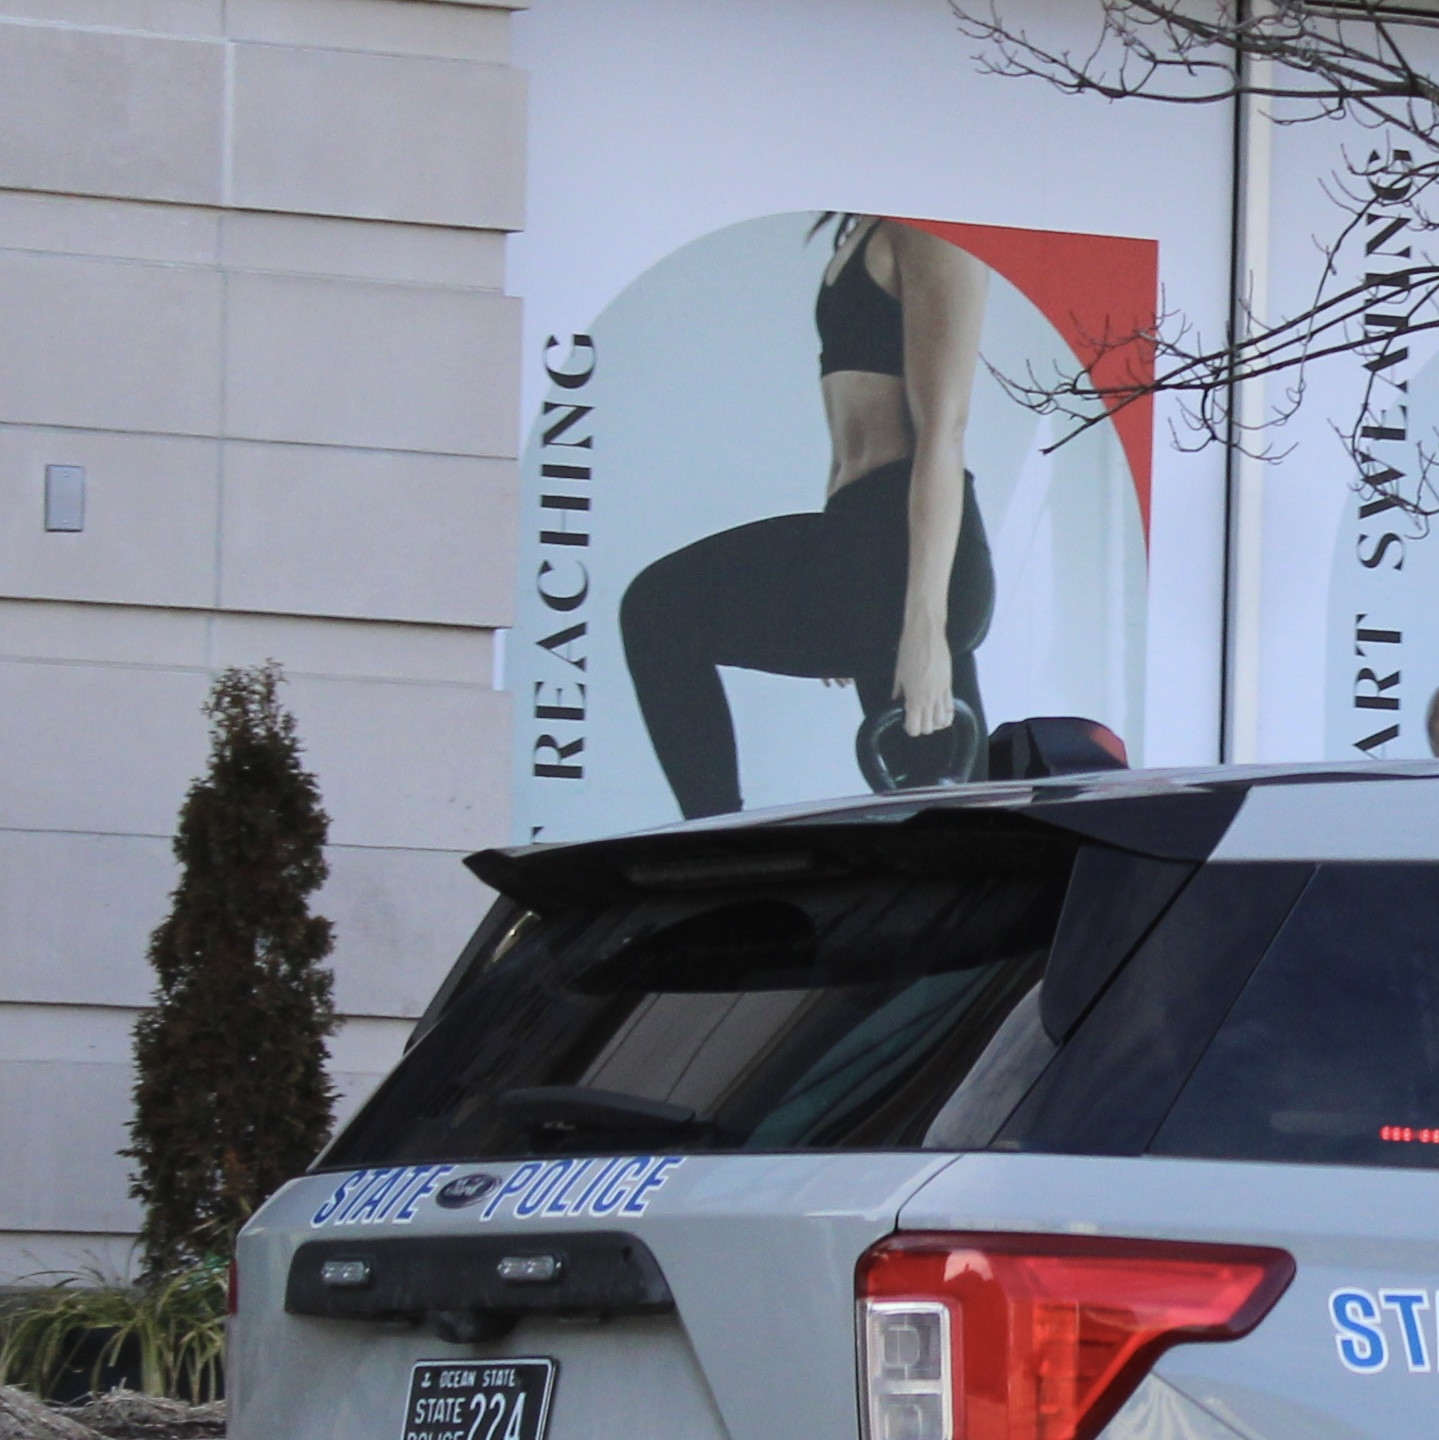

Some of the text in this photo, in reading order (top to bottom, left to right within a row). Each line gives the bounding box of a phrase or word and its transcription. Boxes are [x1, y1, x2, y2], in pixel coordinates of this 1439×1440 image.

[1356, 146, 1413, 571] SWEATING
[533, 331, 598, 780] REACHING
[310, 1155, 686, 1229] STATE POLICE
[414, 1396, 466, 1424] STATE
[440, 1368, 516, 1387] OCEAN STATE
